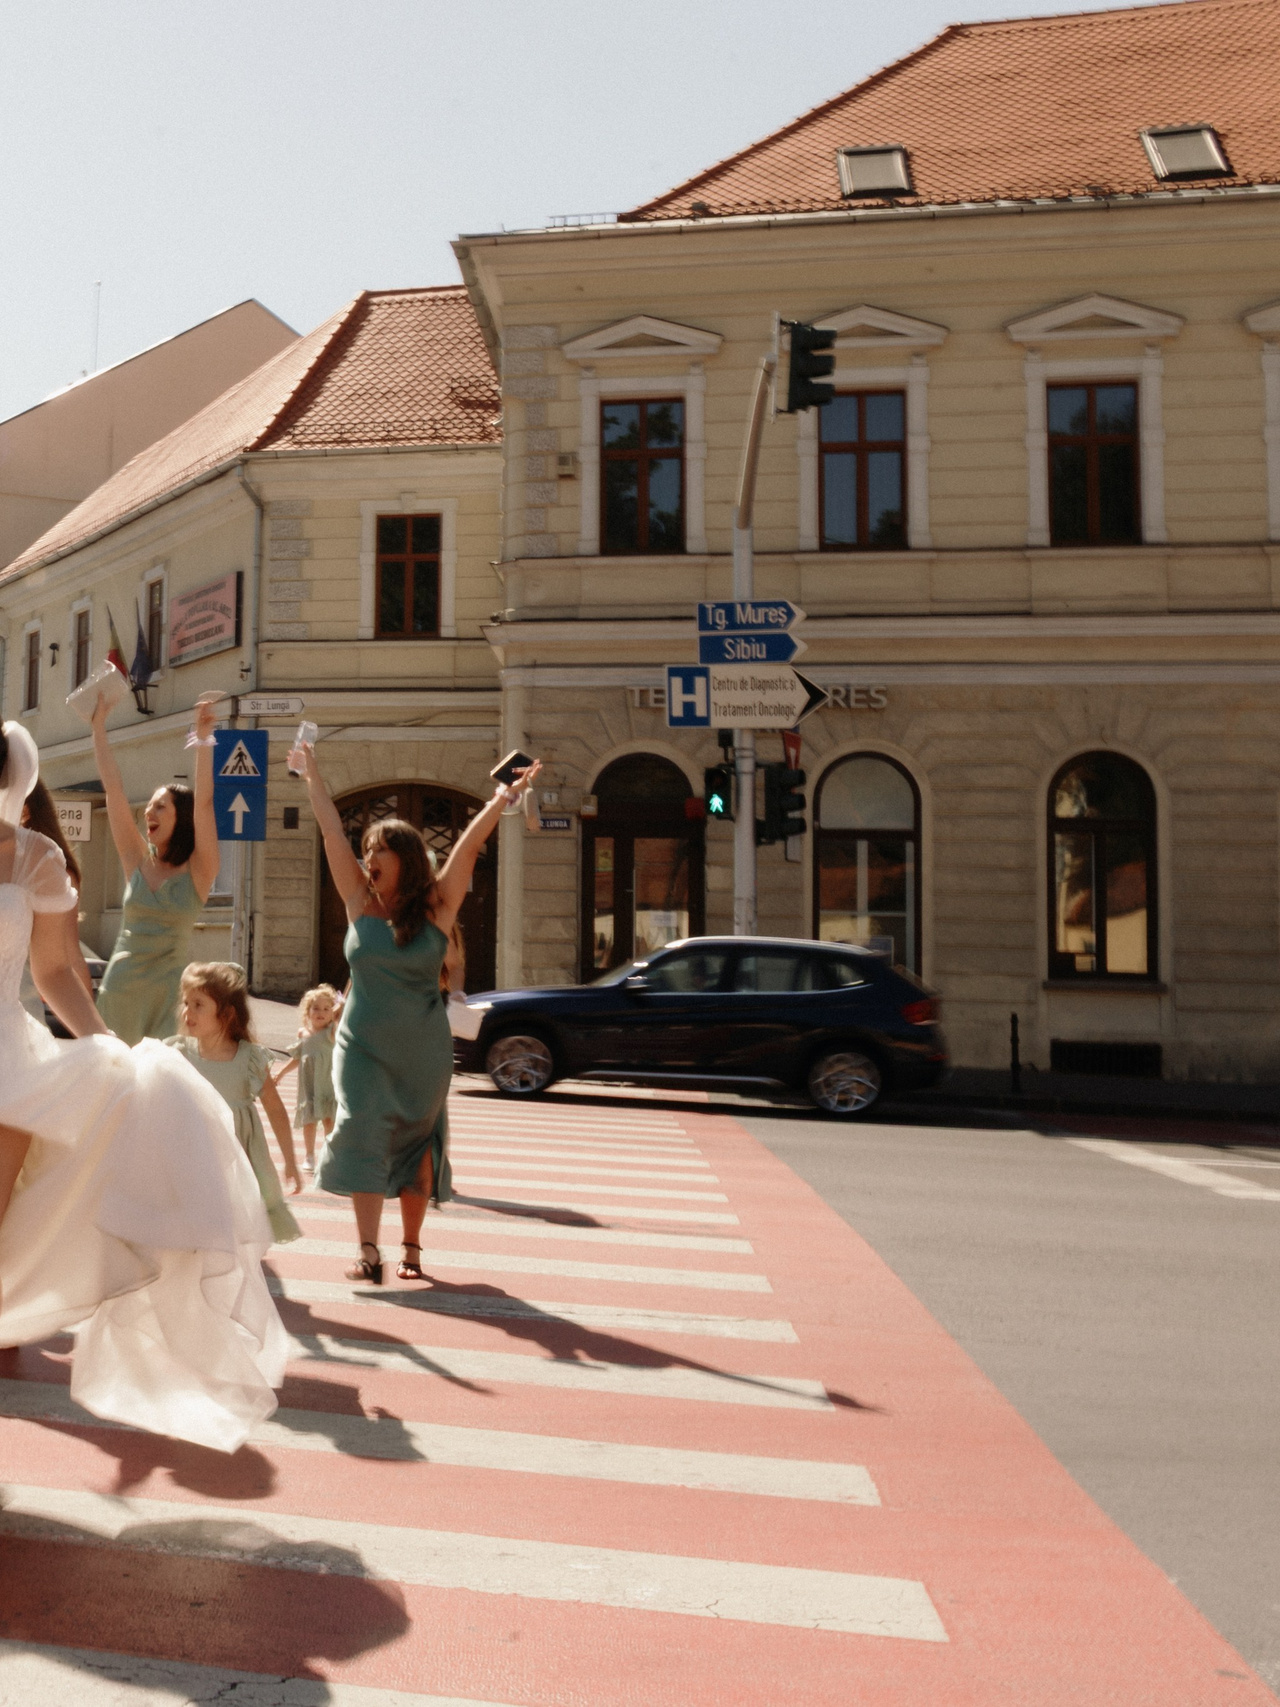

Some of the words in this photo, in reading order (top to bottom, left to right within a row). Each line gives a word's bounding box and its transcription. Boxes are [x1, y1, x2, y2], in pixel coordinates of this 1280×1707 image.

[704, 604, 729, 630] Tg.
[723, 637, 767, 660] Sibiu
[712, 676, 738, 691] Centru
[740, 677, 749, 691] de
[750, 676, 790, 695] Diagnostic
[626, 686, 667, 708] TE
[670, 676, 708, 717] H
[713, 702, 757, 717] Tratament
[758, 701, 797, 721] Oncologic
[55, 806, 83, 820] iana
[61, 825, 82, 836] sov
